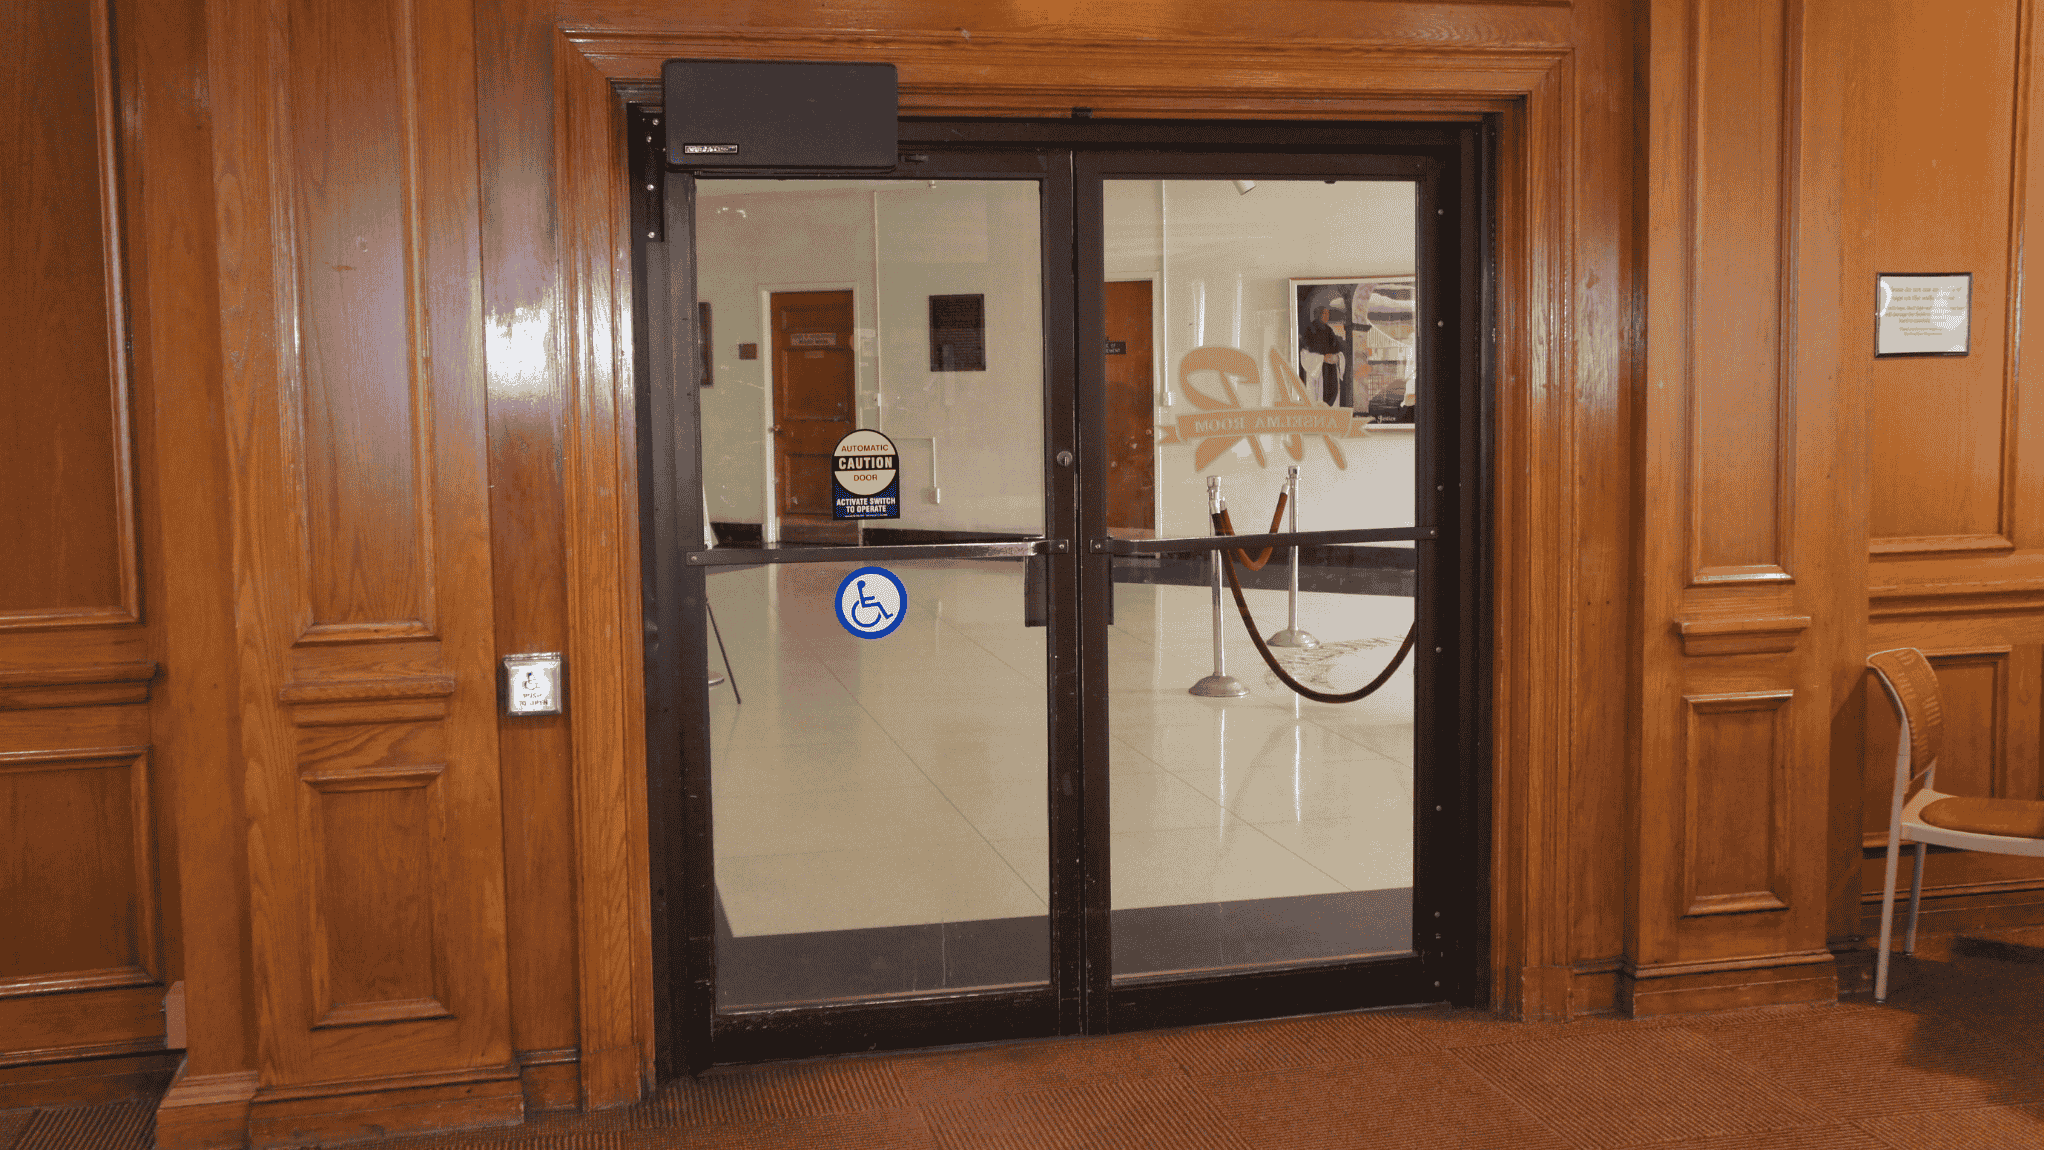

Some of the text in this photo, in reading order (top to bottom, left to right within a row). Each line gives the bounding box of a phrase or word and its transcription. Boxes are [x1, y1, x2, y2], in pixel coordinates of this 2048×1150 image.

[841, 444, 889, 452] AUTOMATIC
[838, 456, 893, 469] CAUTION
[836, 497, 896, 506] ACTIVATE SWITCH
[856, 505, 887, 513] OPERATE
